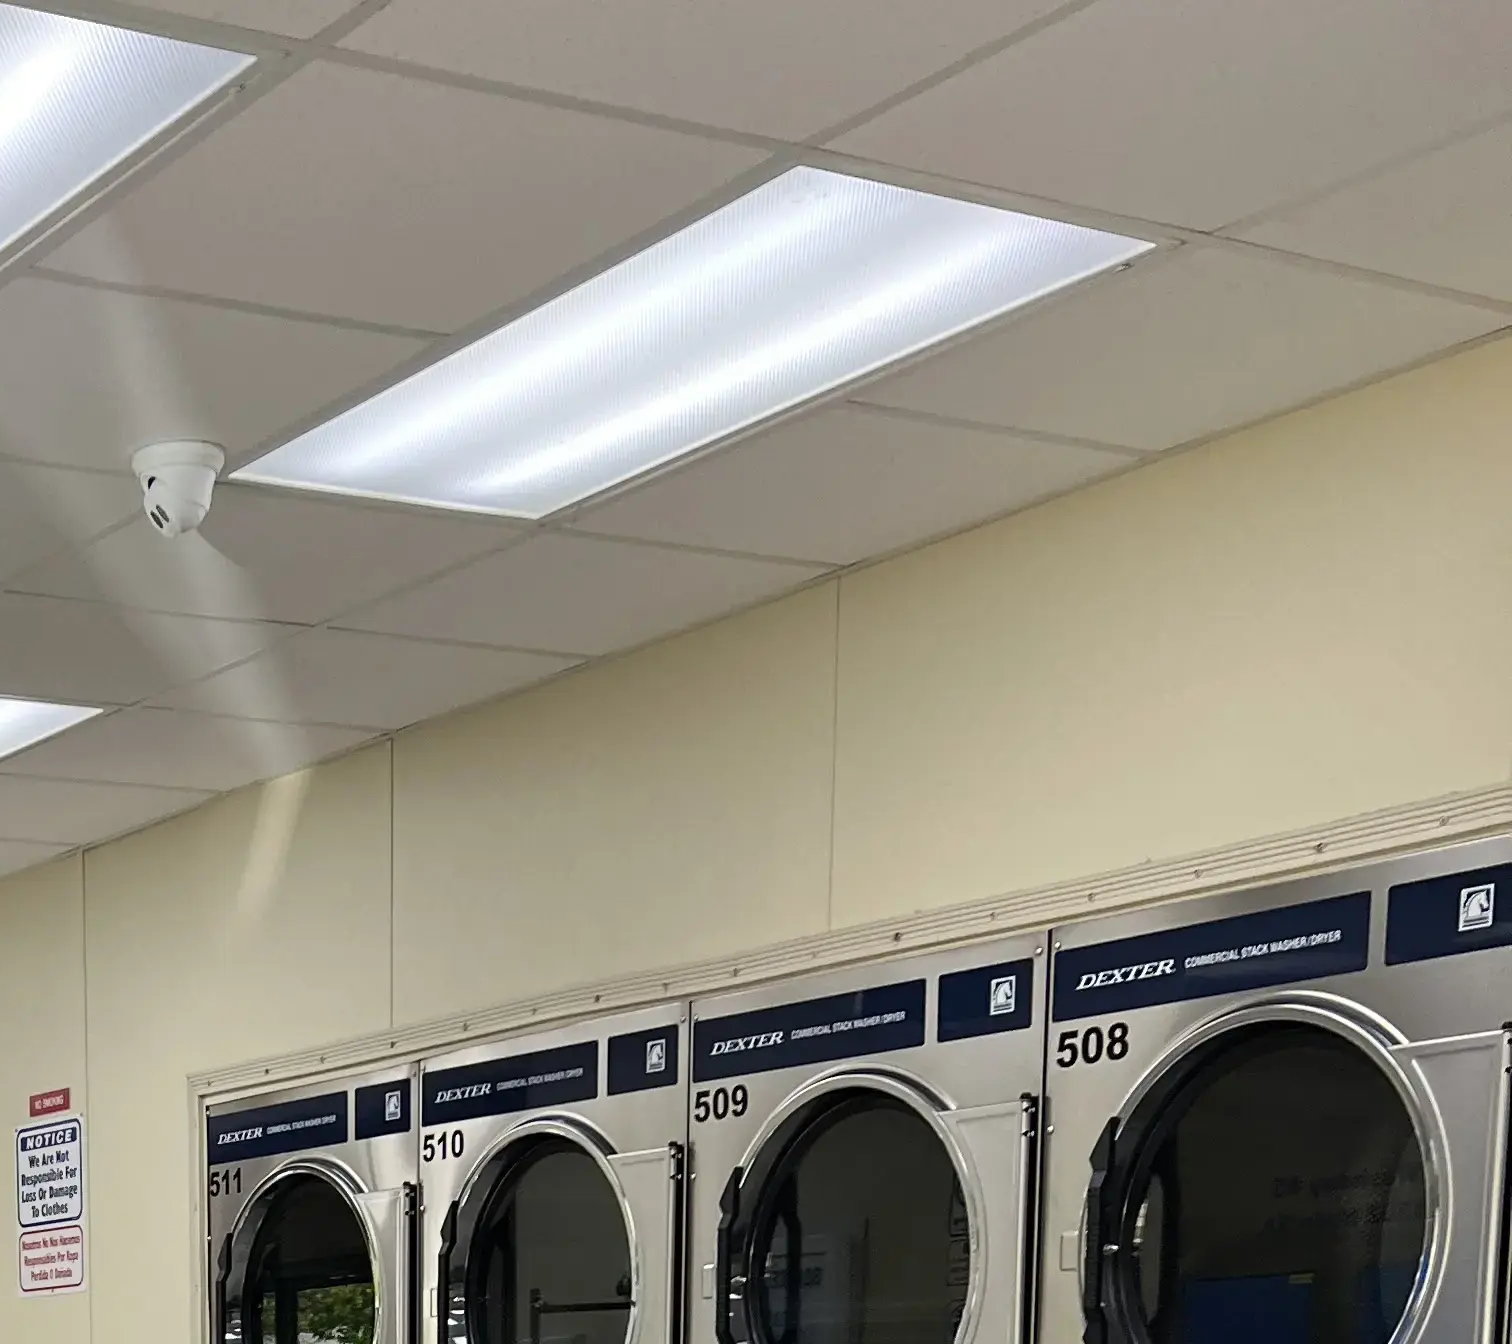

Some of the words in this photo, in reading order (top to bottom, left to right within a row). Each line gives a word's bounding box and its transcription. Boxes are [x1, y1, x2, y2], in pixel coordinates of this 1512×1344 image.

[1075, 958, 1175, 991] DEXTER
[1184, 949, 1240, 969] COMMERCIAL
[1240, 943, 1269, 959] STACK
[708, 1030, 785, 1056] DEXTER
[1056, 1022, 1130, 1068] 508
[434, 1082, 493, 1104] DEXTER
[694, 1084, 748, 1123] 509
[25, 1129, 73, 1150] NOTICE
[217, 1127, 263, 1145] DEXTER
[422, 1129, 465, 1163] 510
[28, 1155, 39, 1168] We
[42, 1153, 54, 1166] Are
[55, 1150, 69, 1163] Not
[65, 1166, 77, 1179] For
[210, 1167, 242, 1197] 511
[22, 1191, 36, 1203] Loss
[39, 1188, 47, 1200] Or
[49, 1185, 77, 1199] Damage
[31, 1205, 39, 1218] To
[41, 1202, 68, 1217] Clothes
